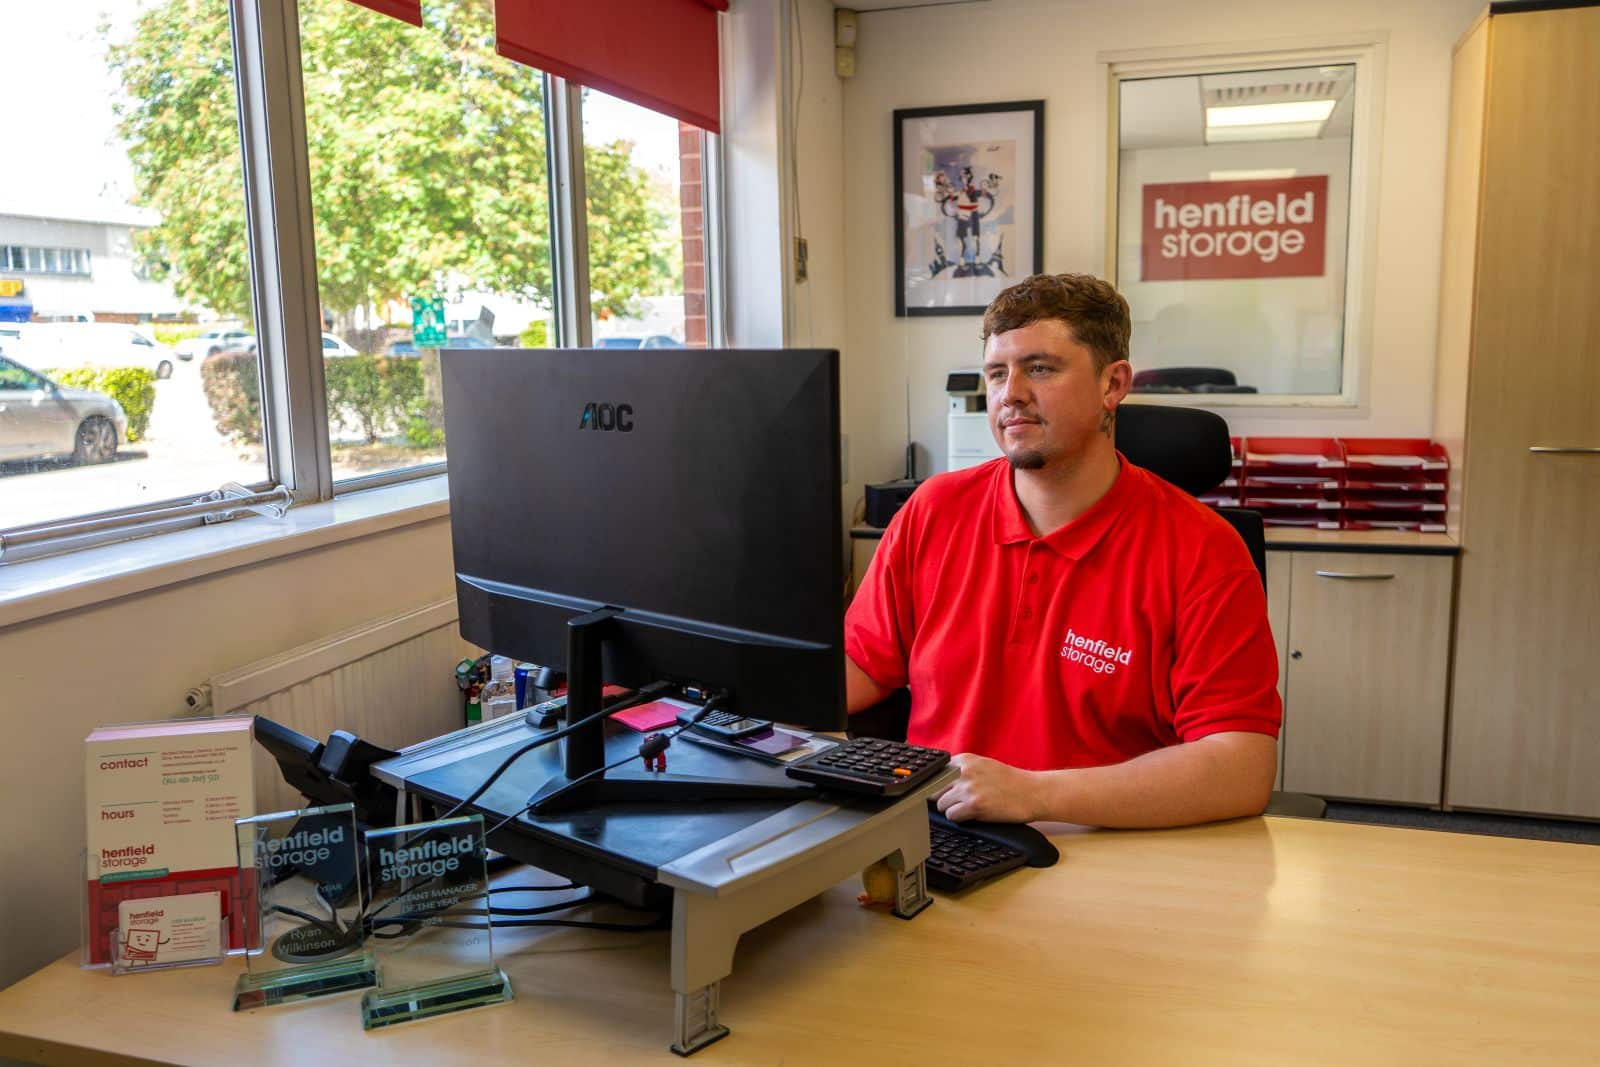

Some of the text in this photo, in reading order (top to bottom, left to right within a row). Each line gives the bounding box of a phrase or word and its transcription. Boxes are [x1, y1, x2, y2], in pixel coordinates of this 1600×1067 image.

[1154, 191, 1314, 229] henfield
[1160, 228, 1305, 263] storage
[579, 402, 634, 432] AOC
[1064, 628, 1132, 666] henfield
[1060, 645, 1116, 674] storage
[100, 757, 148, 770] contact
[101, 809, 135, 820] hours
[102, 844, 155, 859] henfield
[255, 847, 331, 869] storage
[379, 834, 474, 866] henfield
[102, 856, 147, 868] storage
[381, 857, 460, 882] storage
[431, 883, 478, 897] MANAGER
[290, 927, 322, 941] Ryan
[277, 939, 337, 955] Wilkinson
